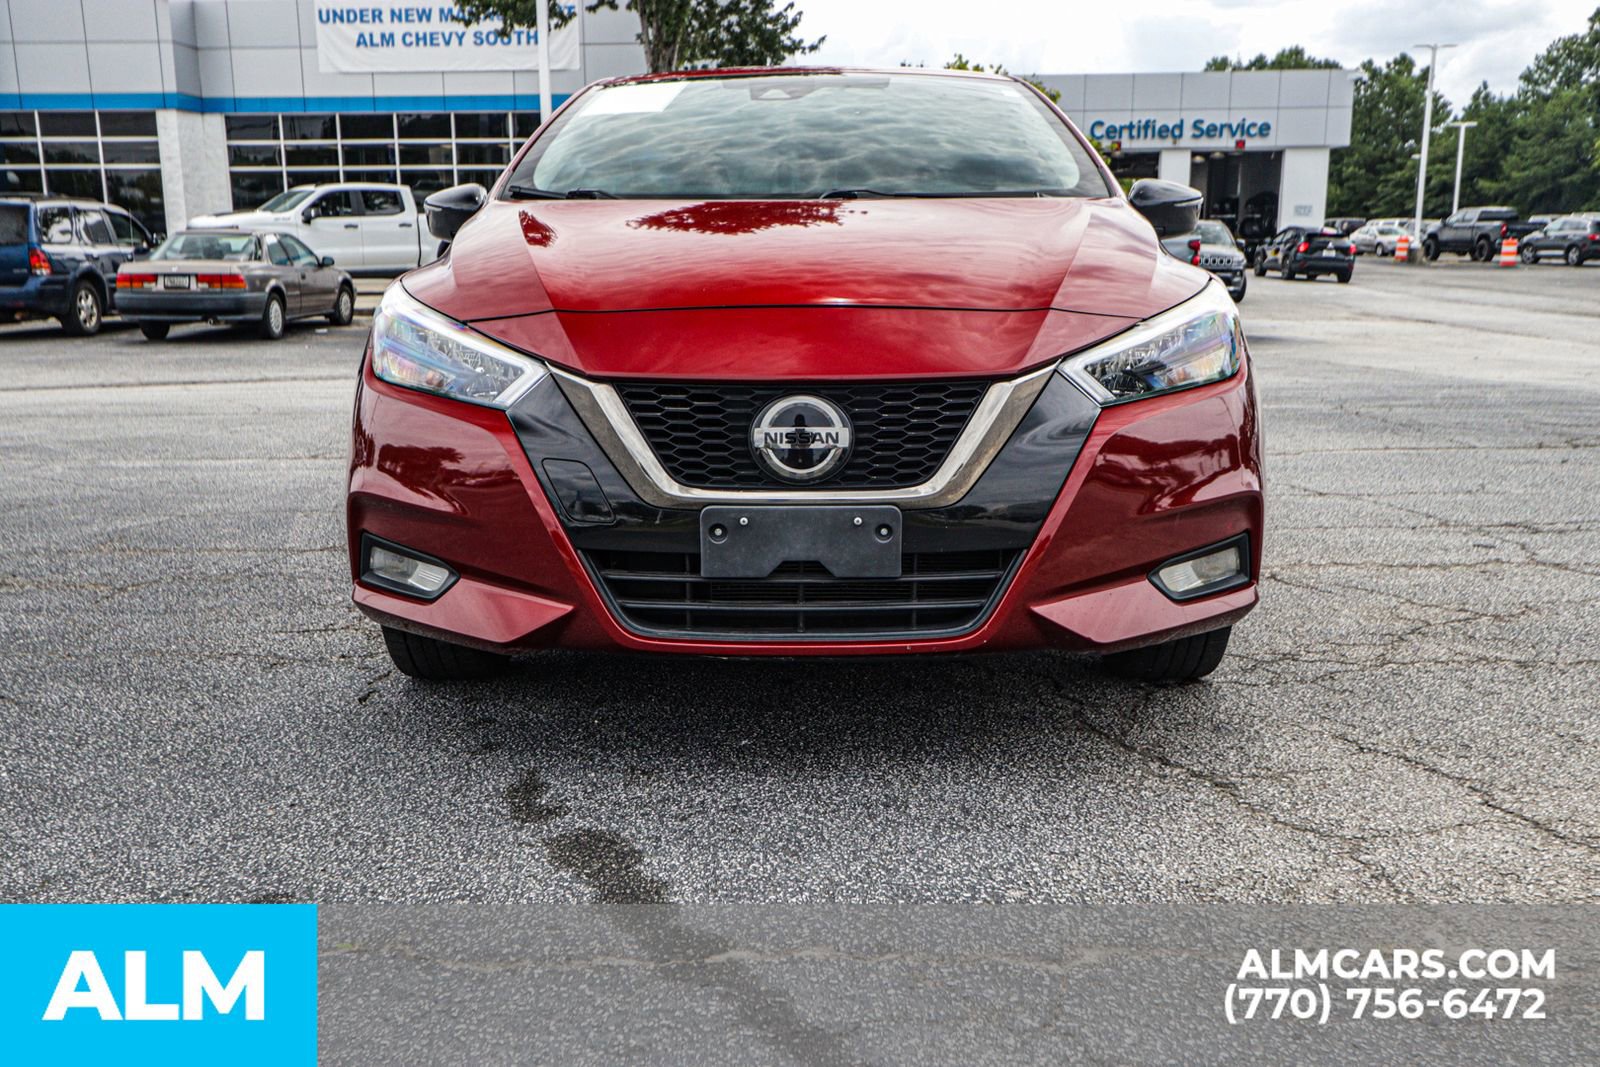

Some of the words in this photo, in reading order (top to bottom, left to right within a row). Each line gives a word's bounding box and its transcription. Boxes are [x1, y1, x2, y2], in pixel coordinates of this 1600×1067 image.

[318, 8, 383, 24] UNDER
[390, 8, 432, 23] NEW
[356, 32, 395, 47] ALM
[401, 31, 466, 47] CHEVY
[1090, 118, 1184, 141] Certified
[1191, 118, 1272, 140] Service
[763, 431, 840, 445] NISSAN
